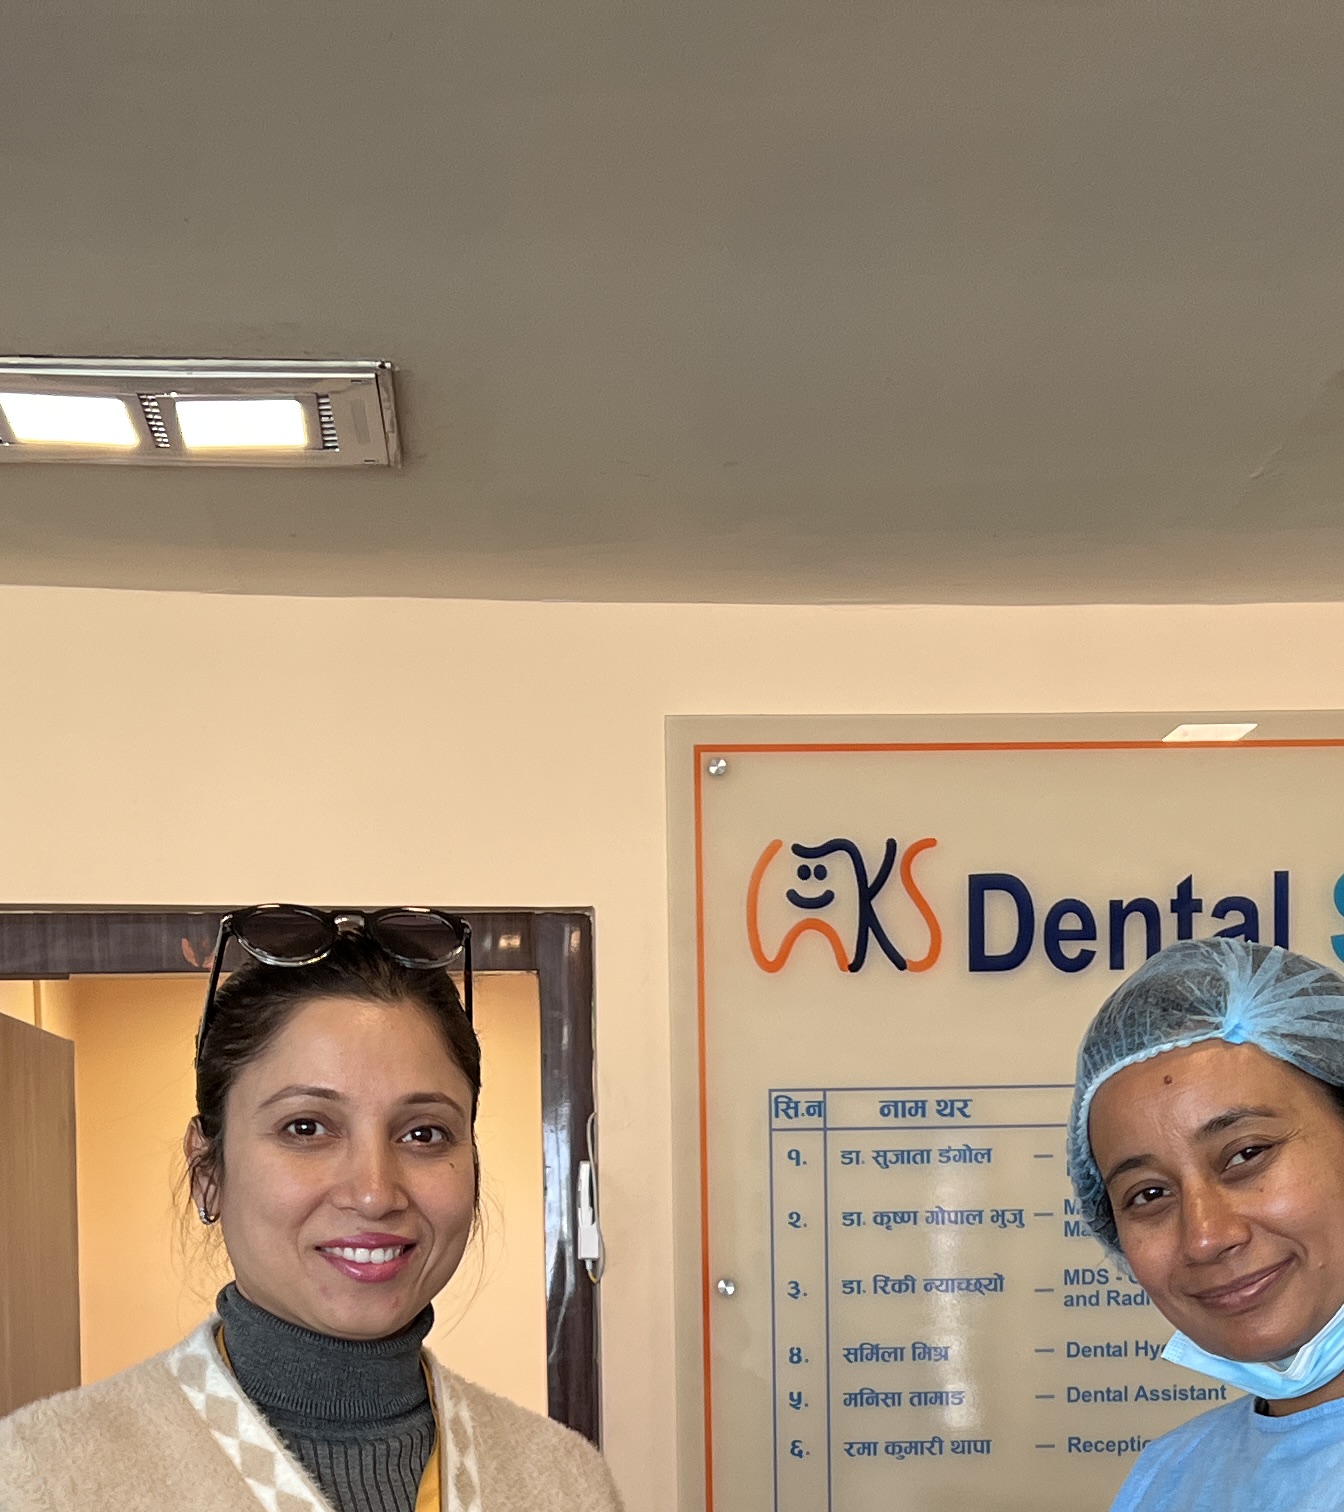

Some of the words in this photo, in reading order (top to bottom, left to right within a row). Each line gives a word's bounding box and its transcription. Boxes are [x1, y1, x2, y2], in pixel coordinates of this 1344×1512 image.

[968, 871, 1289, 972] Dental
[879, 1099, 928, 1118] नाम
[936, 1098, 973, 1118] थर
[840, 1150, 865, 1165] डा.
[872, 1149, 932, 1169] सुजाता
[938, 1144, 993, 1164] डंगोल
[842, 1211, 866, 1227] डा.
[873, 1210, 919, 1230] कृष्ण
[925, 1206, 984, 1225] गोपाल
[990, 1209, 1025, 1228] भुजु
[842, 1279, 866, 1295] डा.
[1064, 1269, 1109, 1285] MDS
[1064, 1290, 1100, 1307] and
[1066, 1341, 1128, 1358] Dental
[843, 1387, 902, 1407] मनिसा
[1066, 1385, 1130, 1403] Dental
[1135, 1384, 1227, 1402] Assistant
[843, 1441, 879, 1456] रमा
[884, 1436, 944, 1460] कुमारी
[950, 1439, 993, 1455] थापा
[1067, 1435, 1151, 1456] Recepti
